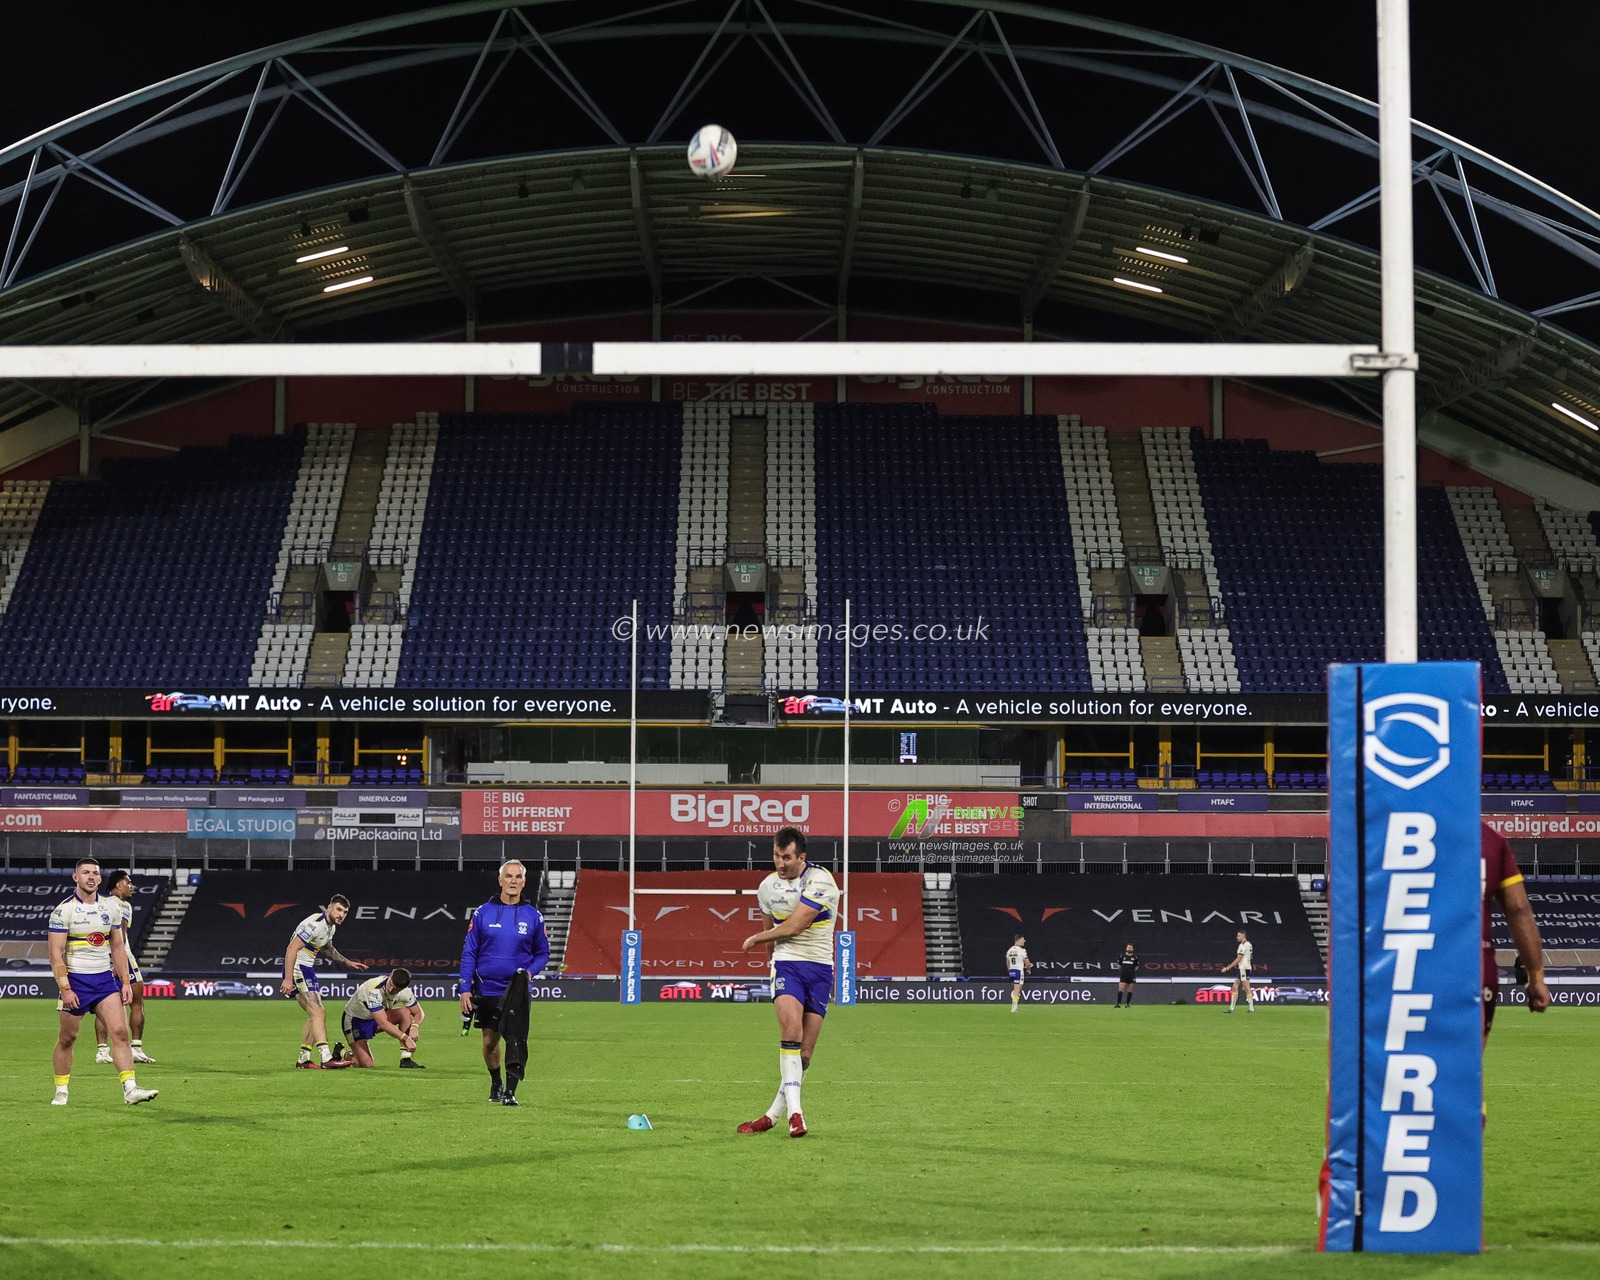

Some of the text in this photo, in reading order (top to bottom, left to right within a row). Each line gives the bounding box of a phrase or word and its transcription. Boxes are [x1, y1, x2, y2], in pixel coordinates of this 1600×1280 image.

[555, 384, 640, 394] CONSTRUCTION
[673, 382, 811, 400] BE THE BEST
[926, 385, 1011, 395] CONSTRUCTION
[255, 695, 302, 711] Auto
[320, 695, 334, 711] A
[339, 695, 406, 711] vehicle
[412, 696, 486, 712] solution
[493, 696, 518, 712] for
[524, 698, 617, 715] everyone.
[890, 698, 937, 714] Auto
[956, 699, 970, 714] A
[975, 698, 1042, 714] vehicle
[1049, 699, 1123, 715] solution
[1129, 699, 1155, 715] for
[1160, 701, 1253, 718] everyone.
[1480, 702, 1497, 717] to
[1516, 702, 1529, 716] A
[1535, 701, 1600, 717] vehicle
[14, 792, 77, 801] FANTASTIC MEDIA
[358, 795, 407, 803] INNERVA.COM
[483, 792, 525, 804] BE BIG
[925, 793, 948, 806] BIG
[1022, 796, 1038, 807] SHOT
[1093, 794, 1133, 802] WEEDFREE
[1210, 798, 1235, 806] HTAFC
[1084, 802, 1143, 810] INTERNATIONAL
[1510, 799, 1534, 807] HTAFC
[483, 806, 573, 818] BE DIFFERENT
[670, 793, 810, 828] BigRed
[187, 819, 295, 833] LEGAL STUDIO
[483, 821, 565, 832] BE THE BEST
[733, 824, 810, 833] CONSTRUON
[954, 822, 989, 835] BEST
[326, 828, 443, 840] BMPackaging Ltd
[1091, 908, 1283, 924] VENARI
[640, 959, 708, 968] RIVEN
[713, 960, 739, 968] BY
[626, 947, 636, 1002] BETFRED
[841, 948, 850, 1003] BETFRED
[659, 984, 702, 999] amt
[906, 986, 975, 1001] solution
[981, 986, 1005, 1001] for
[1010, 988, 1096, 1004] everyone.
[1510, 988, 1526, 1003] fo
[1379, 810, 1438, 1233] BETFRED
